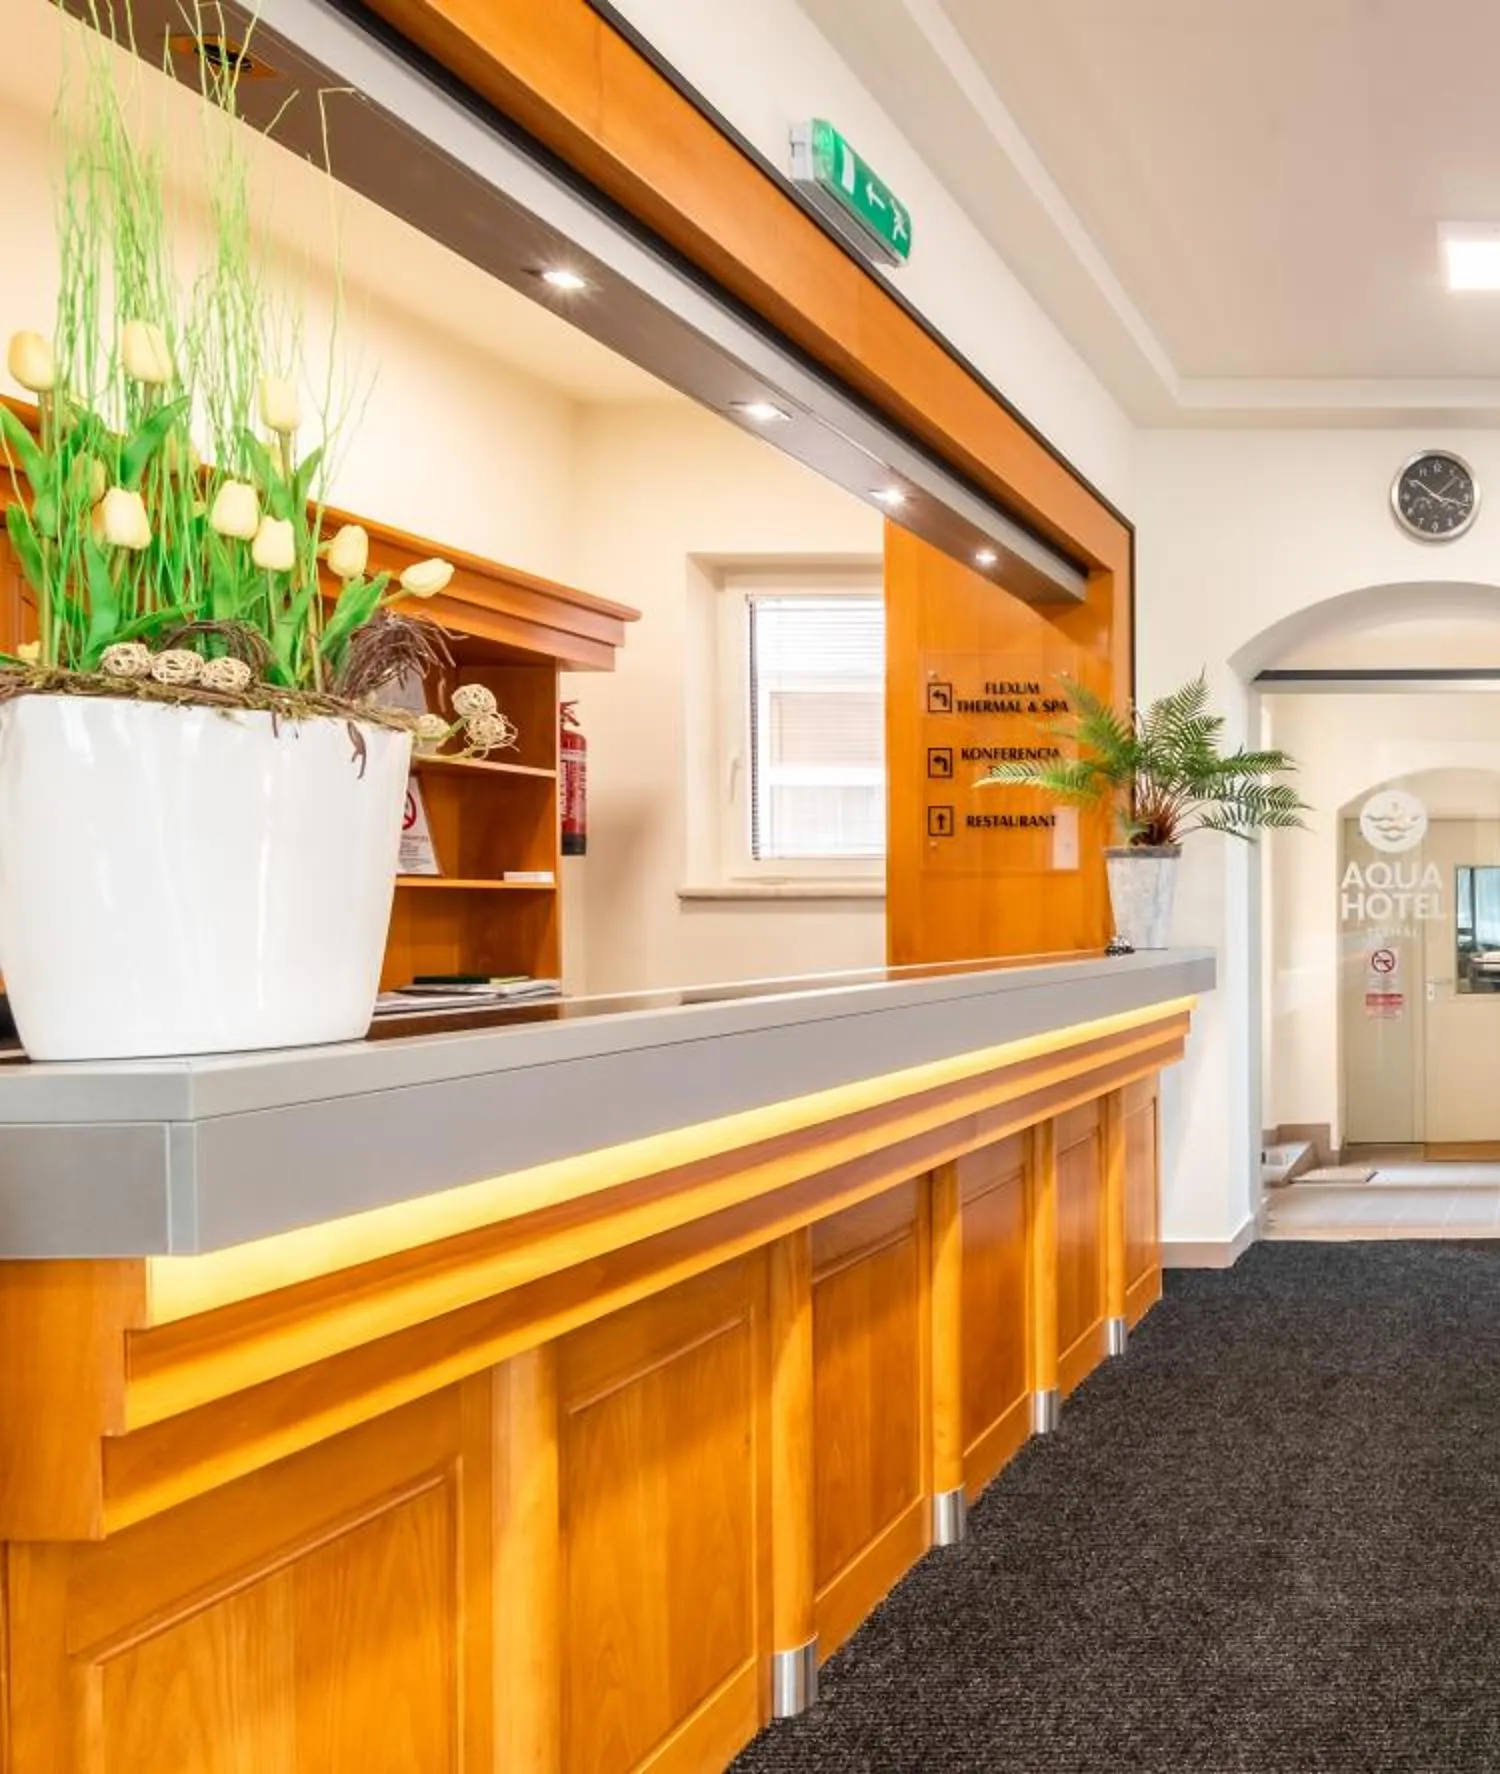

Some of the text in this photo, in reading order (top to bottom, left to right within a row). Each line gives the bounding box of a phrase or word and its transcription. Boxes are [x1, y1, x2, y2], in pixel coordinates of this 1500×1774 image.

[985, 682, 1040, 695] FLEXUM
[956, 699, 1070, 713] THERMAL & SPA
[966, 815, 1057, 828] RESTAURANT
[1341, 861, 1443, 889] AQUA
[1341, 892, 1447, 921] HOTEL
